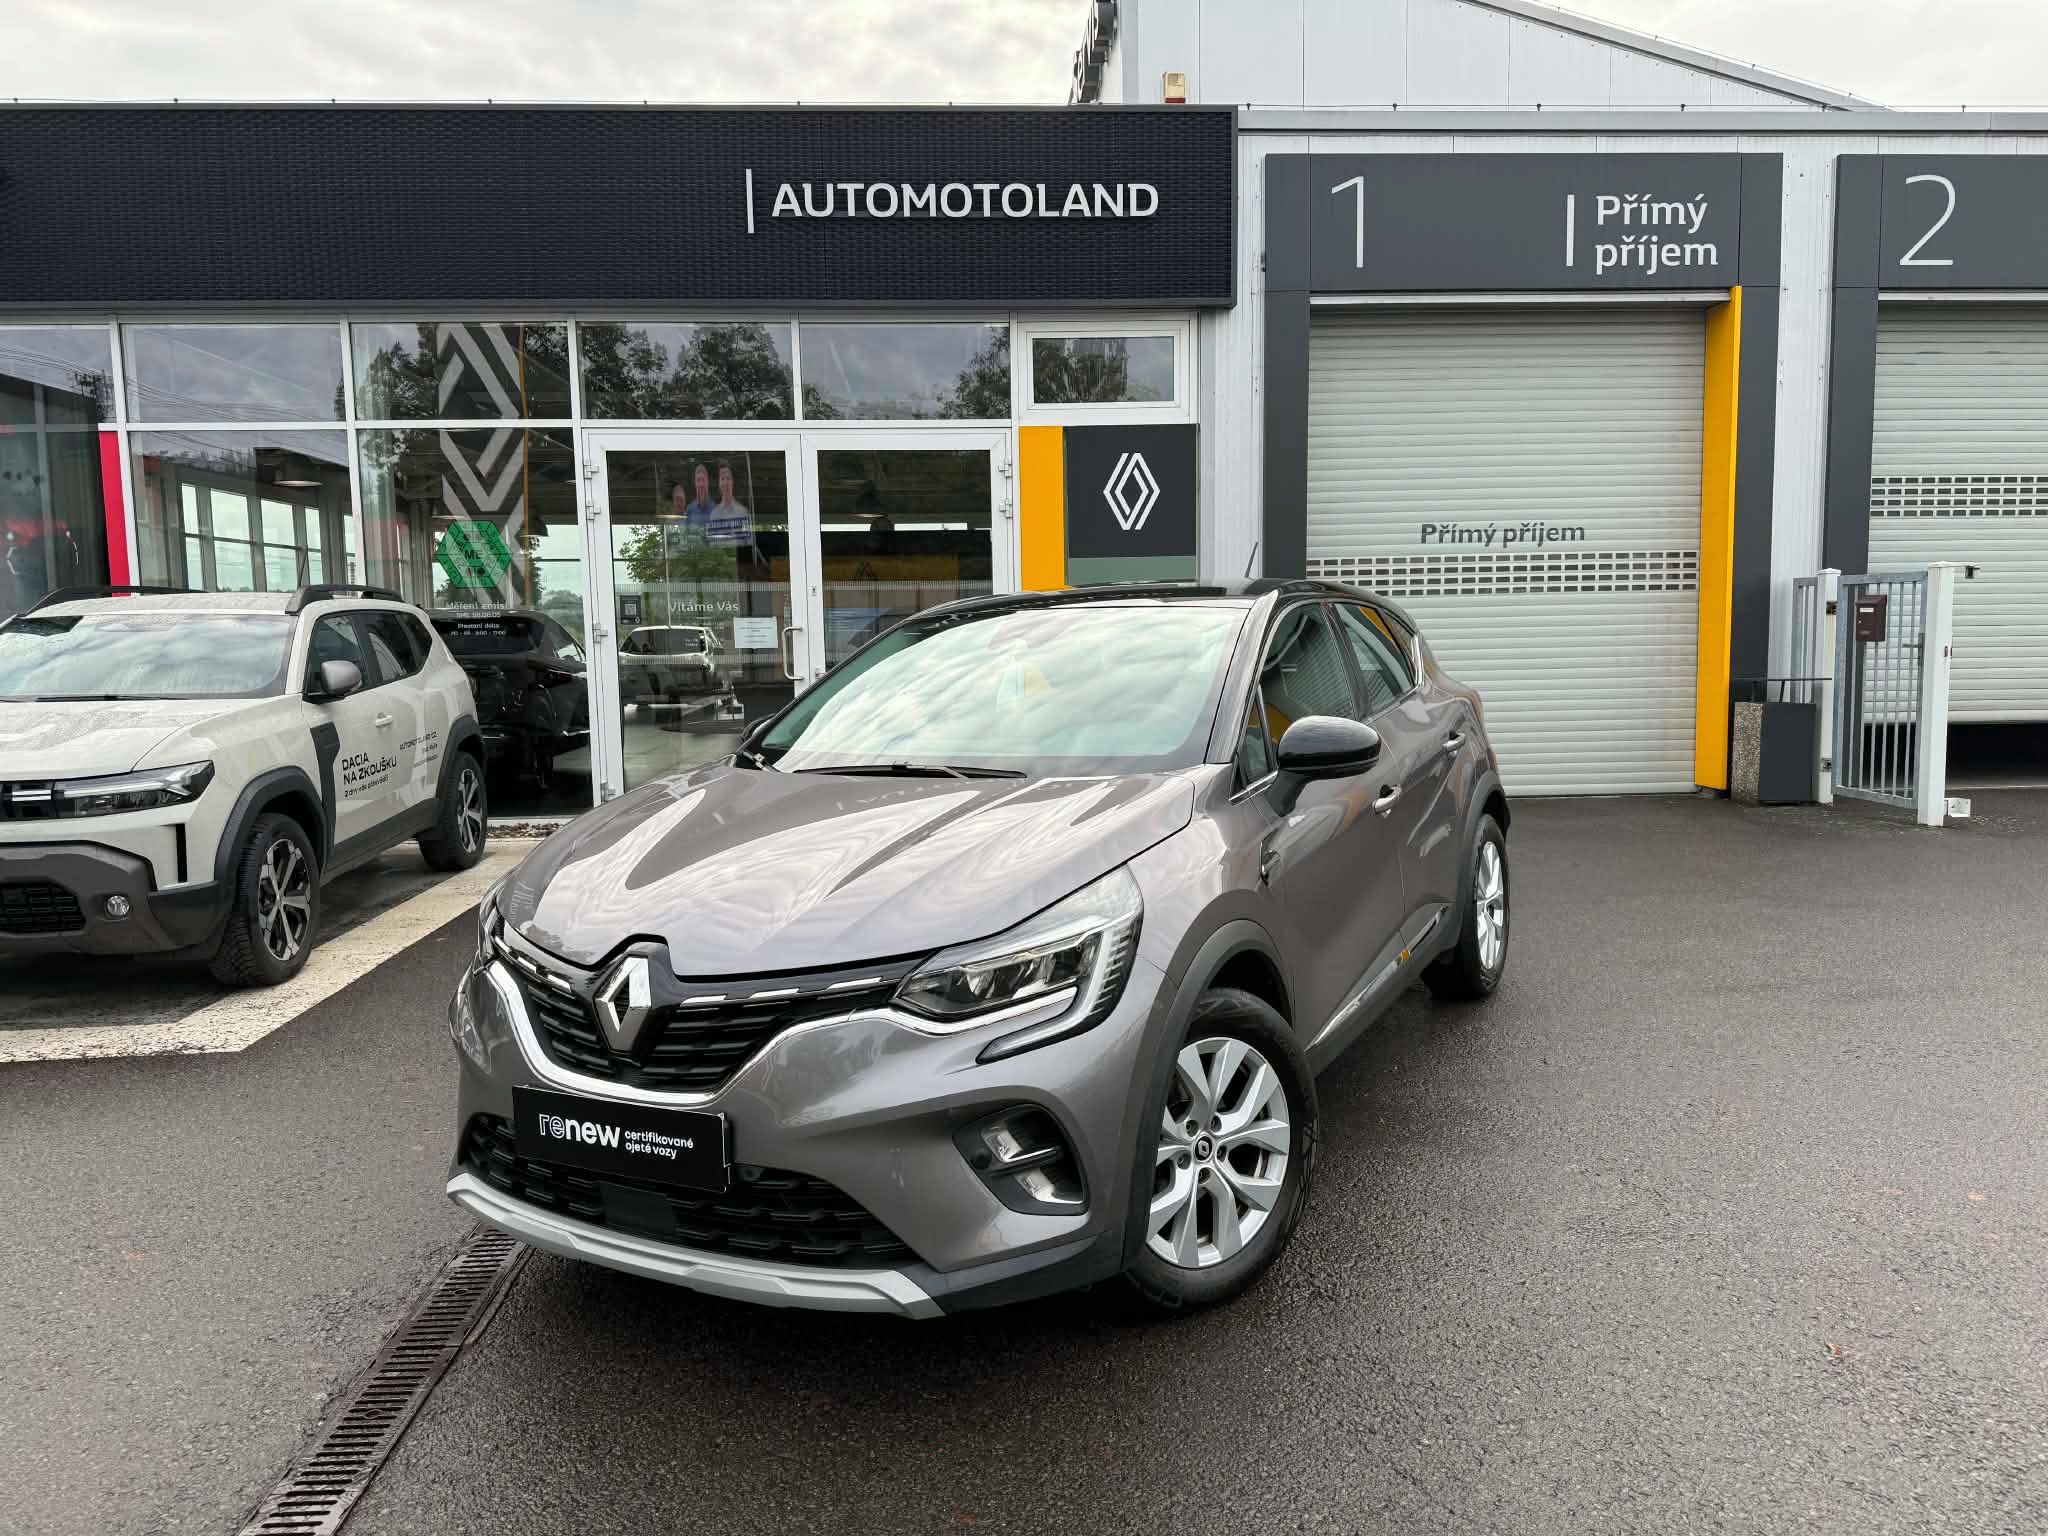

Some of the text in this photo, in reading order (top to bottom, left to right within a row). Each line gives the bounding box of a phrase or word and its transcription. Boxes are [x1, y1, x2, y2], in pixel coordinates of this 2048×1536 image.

[771, 183, 1159, 217] AUTOMOTOLAND
[1595, 193, 1708, 233] Přímý
[1331, 175, 1364, 268] 1
[1900, 174, 1956, 266] 2
[1595, 235, 1719, 275] příjem
[1420, 521, 1586, 548] Přímý příjem
[669, 601, 740, 612] Vítáme Vás
[342, 752, 369, 771] DACIA
[343, 771, 358, 785] NA
[358, 755, 397, 780] ZKOUŠKU
[539, 1114, 694, 1149] renew certifikované
[625, 1141, 677, 1159] ojeté vozy
